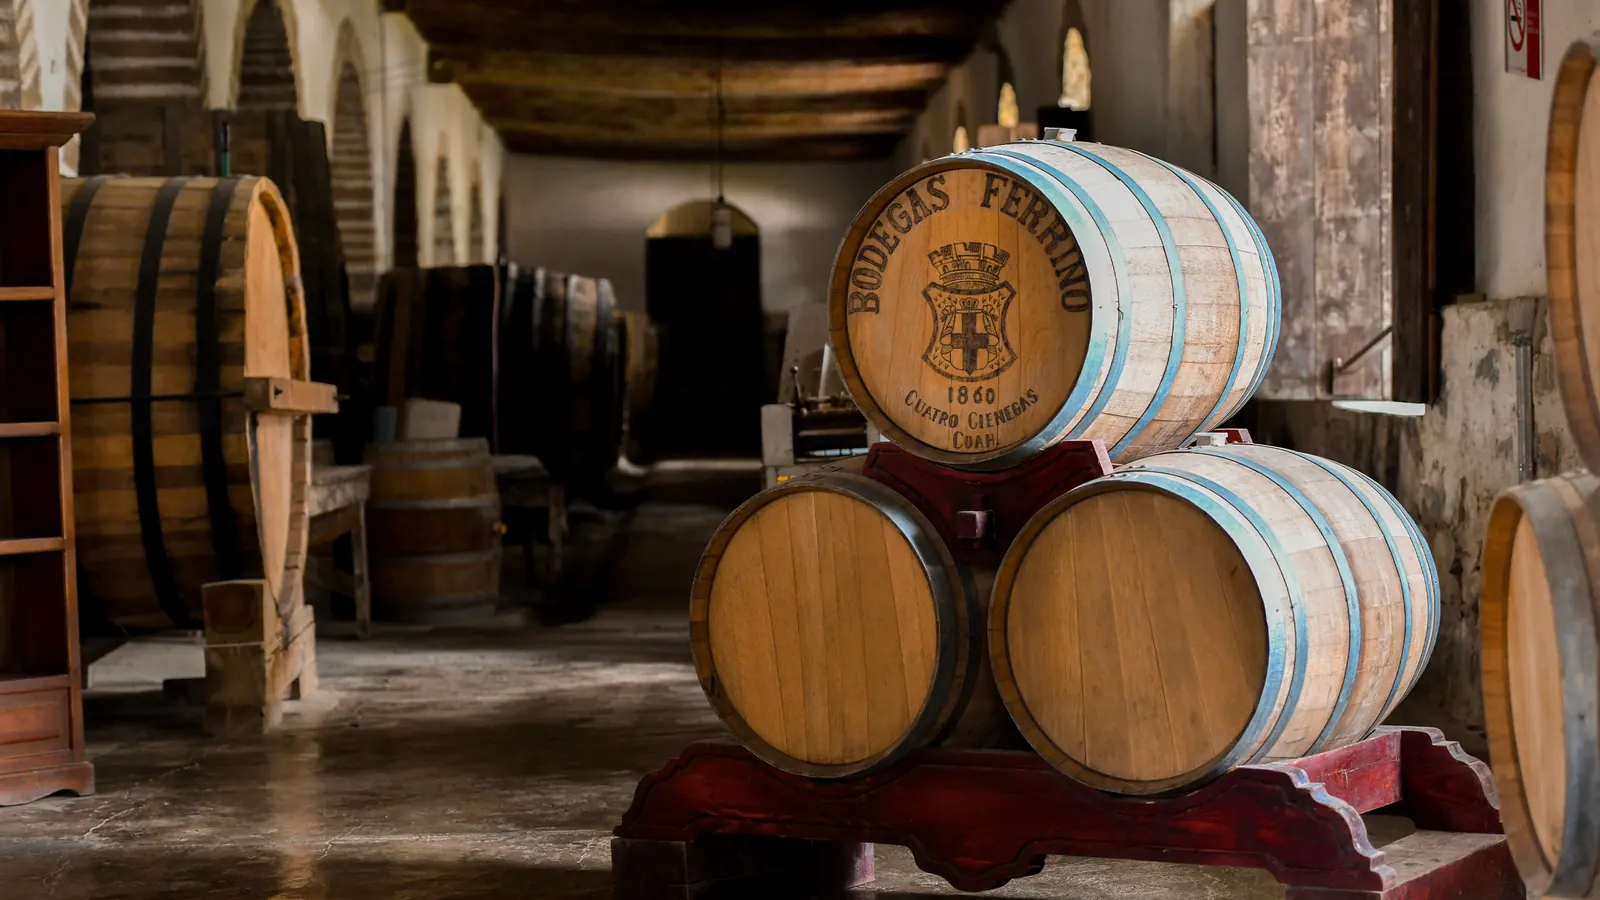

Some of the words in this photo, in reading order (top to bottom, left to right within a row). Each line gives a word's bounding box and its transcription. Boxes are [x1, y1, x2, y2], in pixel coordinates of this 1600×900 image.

[848, 174, 950, 315] BODEGAS
[981, 172, 1092, 313] FERRINO
[905, 389, 958, 428] CUATRO
[968, 389, 1039, 429] CIENEGAS
[948, 386, 995, 405] 1860
